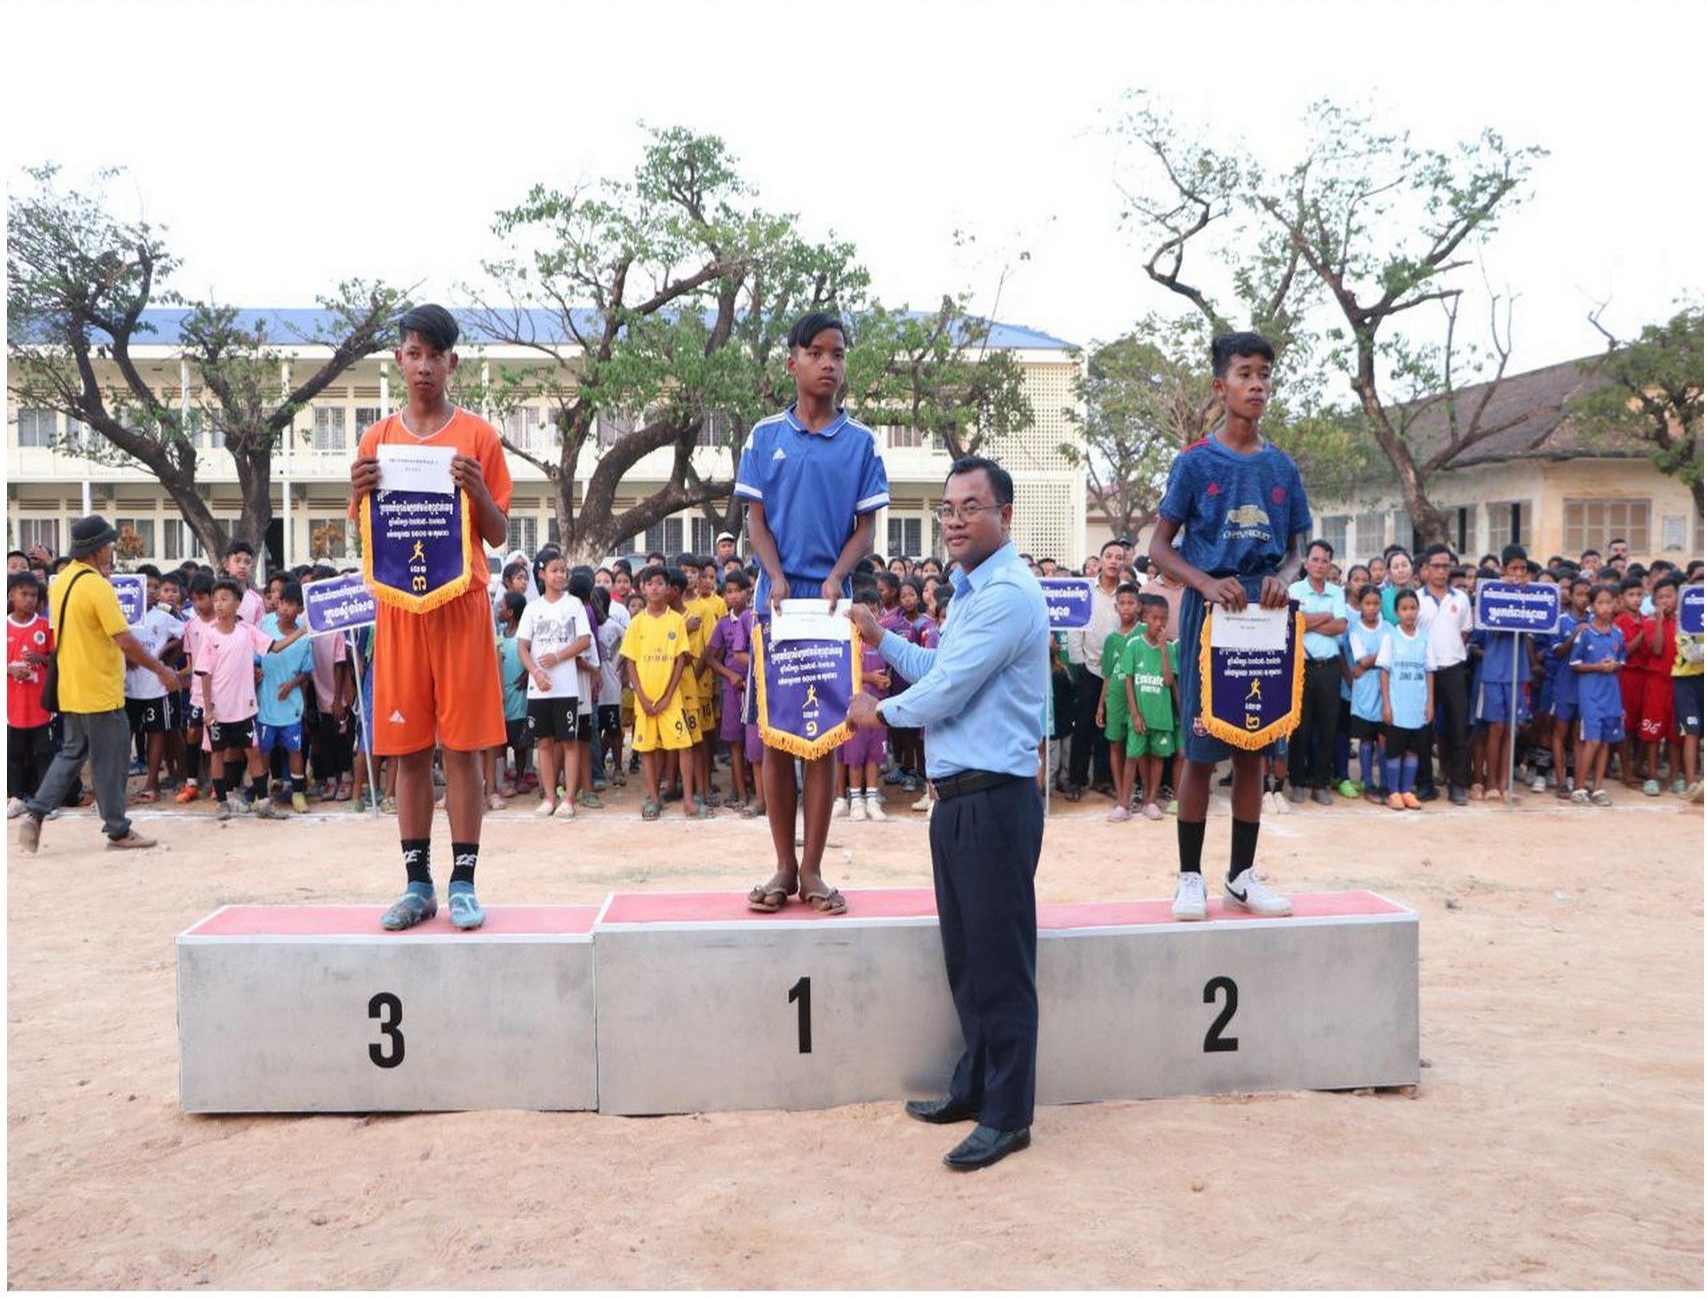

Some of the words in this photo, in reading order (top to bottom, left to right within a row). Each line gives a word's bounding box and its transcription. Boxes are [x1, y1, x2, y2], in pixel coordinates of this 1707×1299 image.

[412, 575, 427, 591] ៣
[146, 707, 156, 722] 3
[566, 711, 574, 725] 9
[688, 715, 697, 730] 8
[1245, 713, 1260, 730] ២
[675, 721, 684, 735] 9
[805, 720, 818, 736] ១
[789, 978, 811, 1053] 1
[1204, 977, 1238, 1052] 2
[369, 993, 404, 1068] 3
